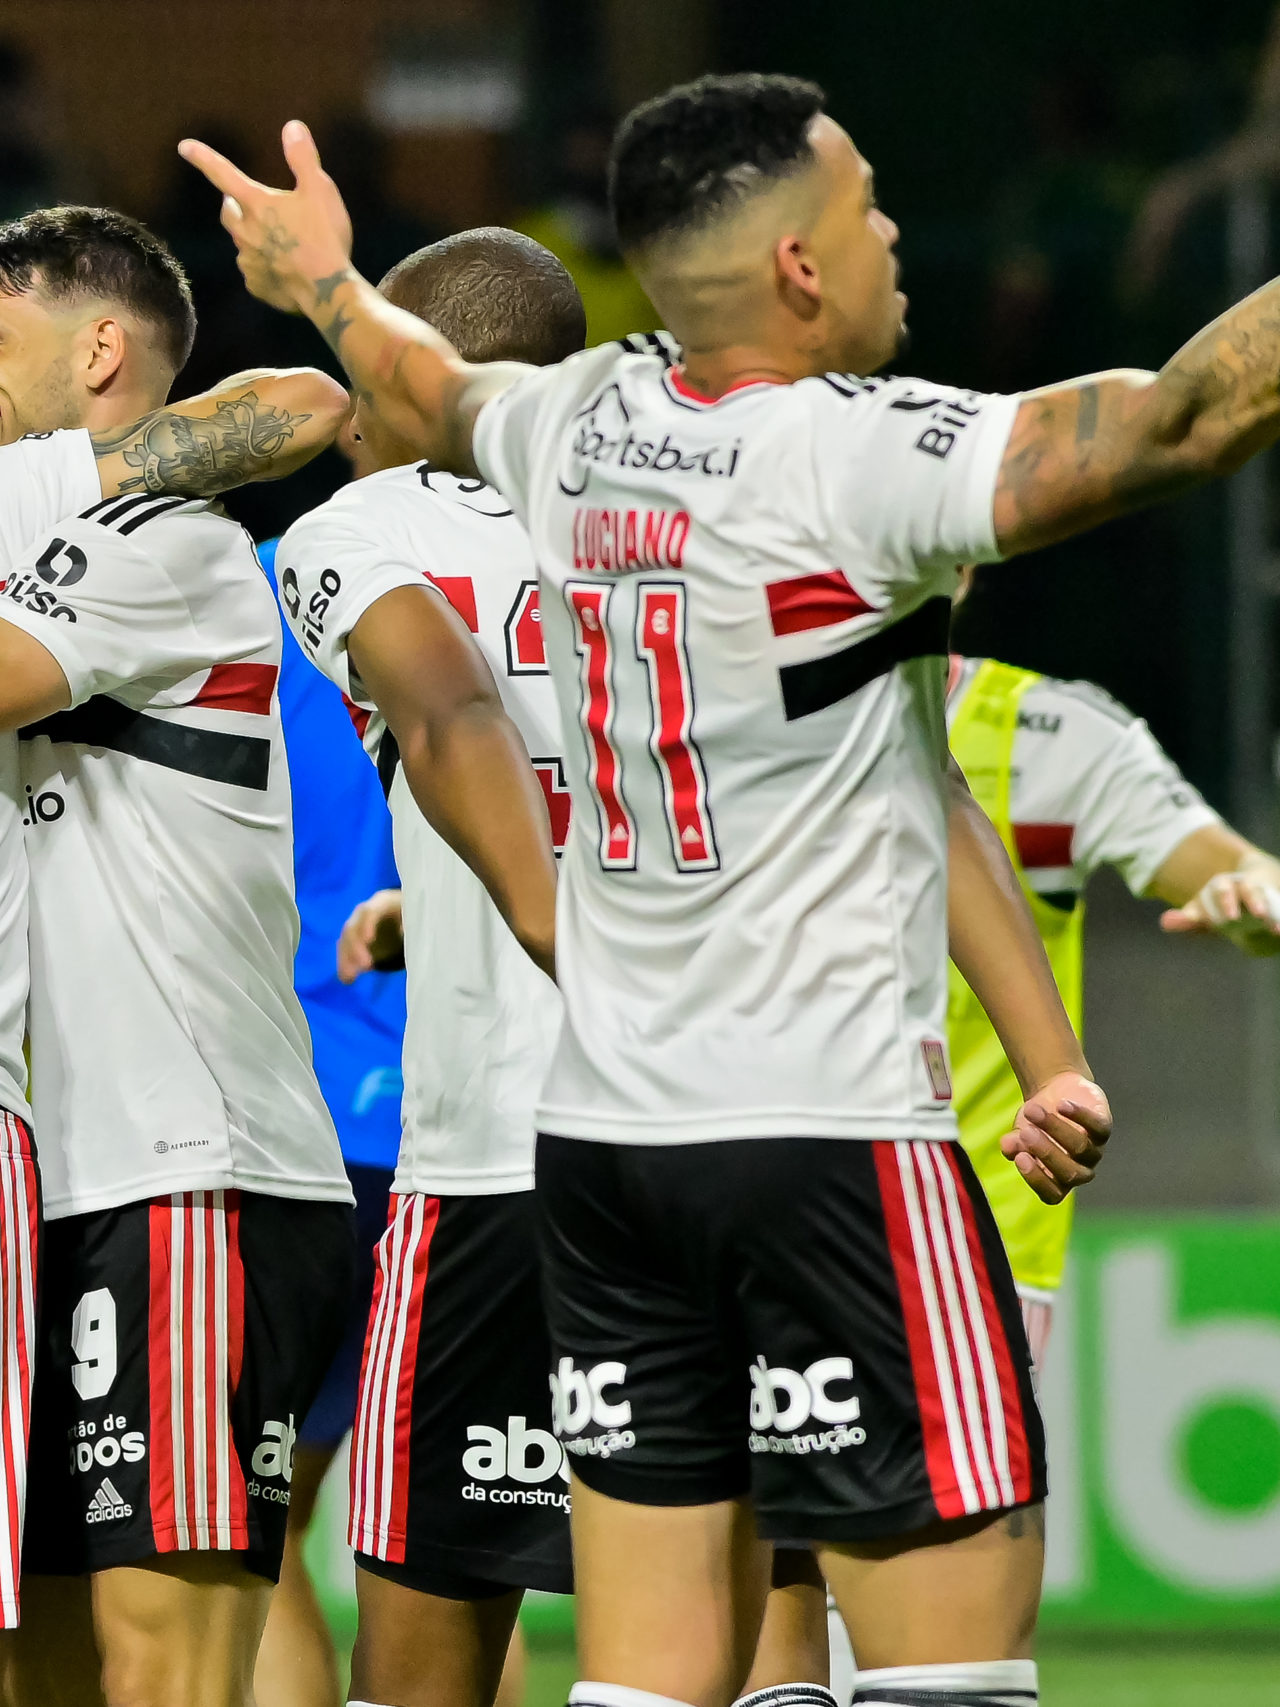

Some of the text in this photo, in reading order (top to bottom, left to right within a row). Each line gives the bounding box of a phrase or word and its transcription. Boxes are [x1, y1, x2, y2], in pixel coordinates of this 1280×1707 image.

[573, 508, 690, 570] LUCIANO
[303, 568, 341, 661] itso
[563, 580, 721, 873] 11
[71, 1287, 118, 1401] 9
[103, 1414, 127, 1433] de
[86, 1503, 133, 1524] adidas
[461, 1482, 486, 1501] da
